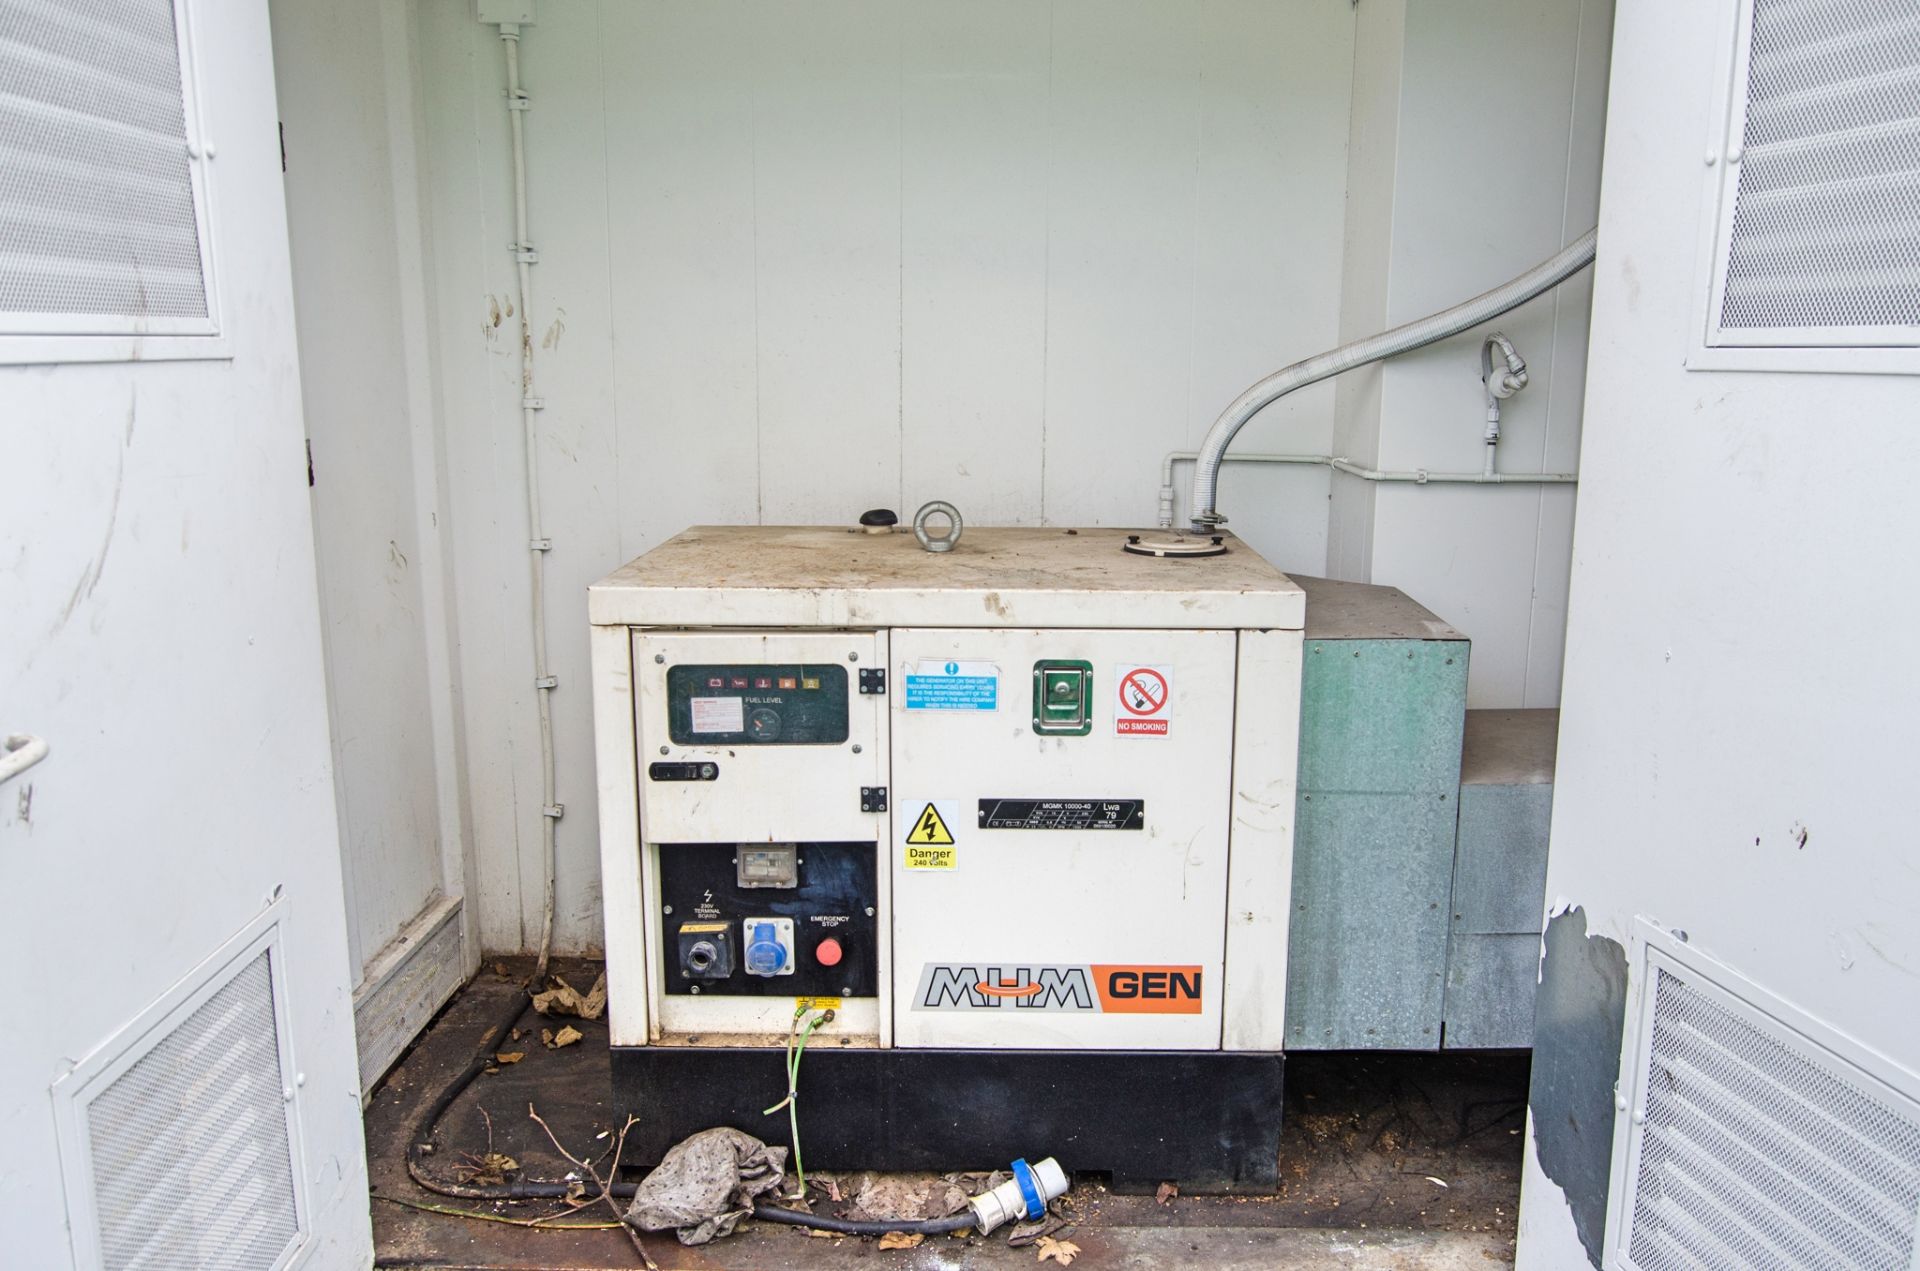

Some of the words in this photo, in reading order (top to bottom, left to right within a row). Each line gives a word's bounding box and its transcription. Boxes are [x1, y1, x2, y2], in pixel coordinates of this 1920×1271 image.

[1118, 722, 1130, 730] NO
[1131, 723, 1166, 731] SMOKING
[1103, 802, 1120, 810] Lwa
[1106, 811, 1117, 819] 79
[910, 848, 951, 860] Danger
[923, 966, 1094, 1009] MHM
[1108, 972, 1201, 1000] GEN
